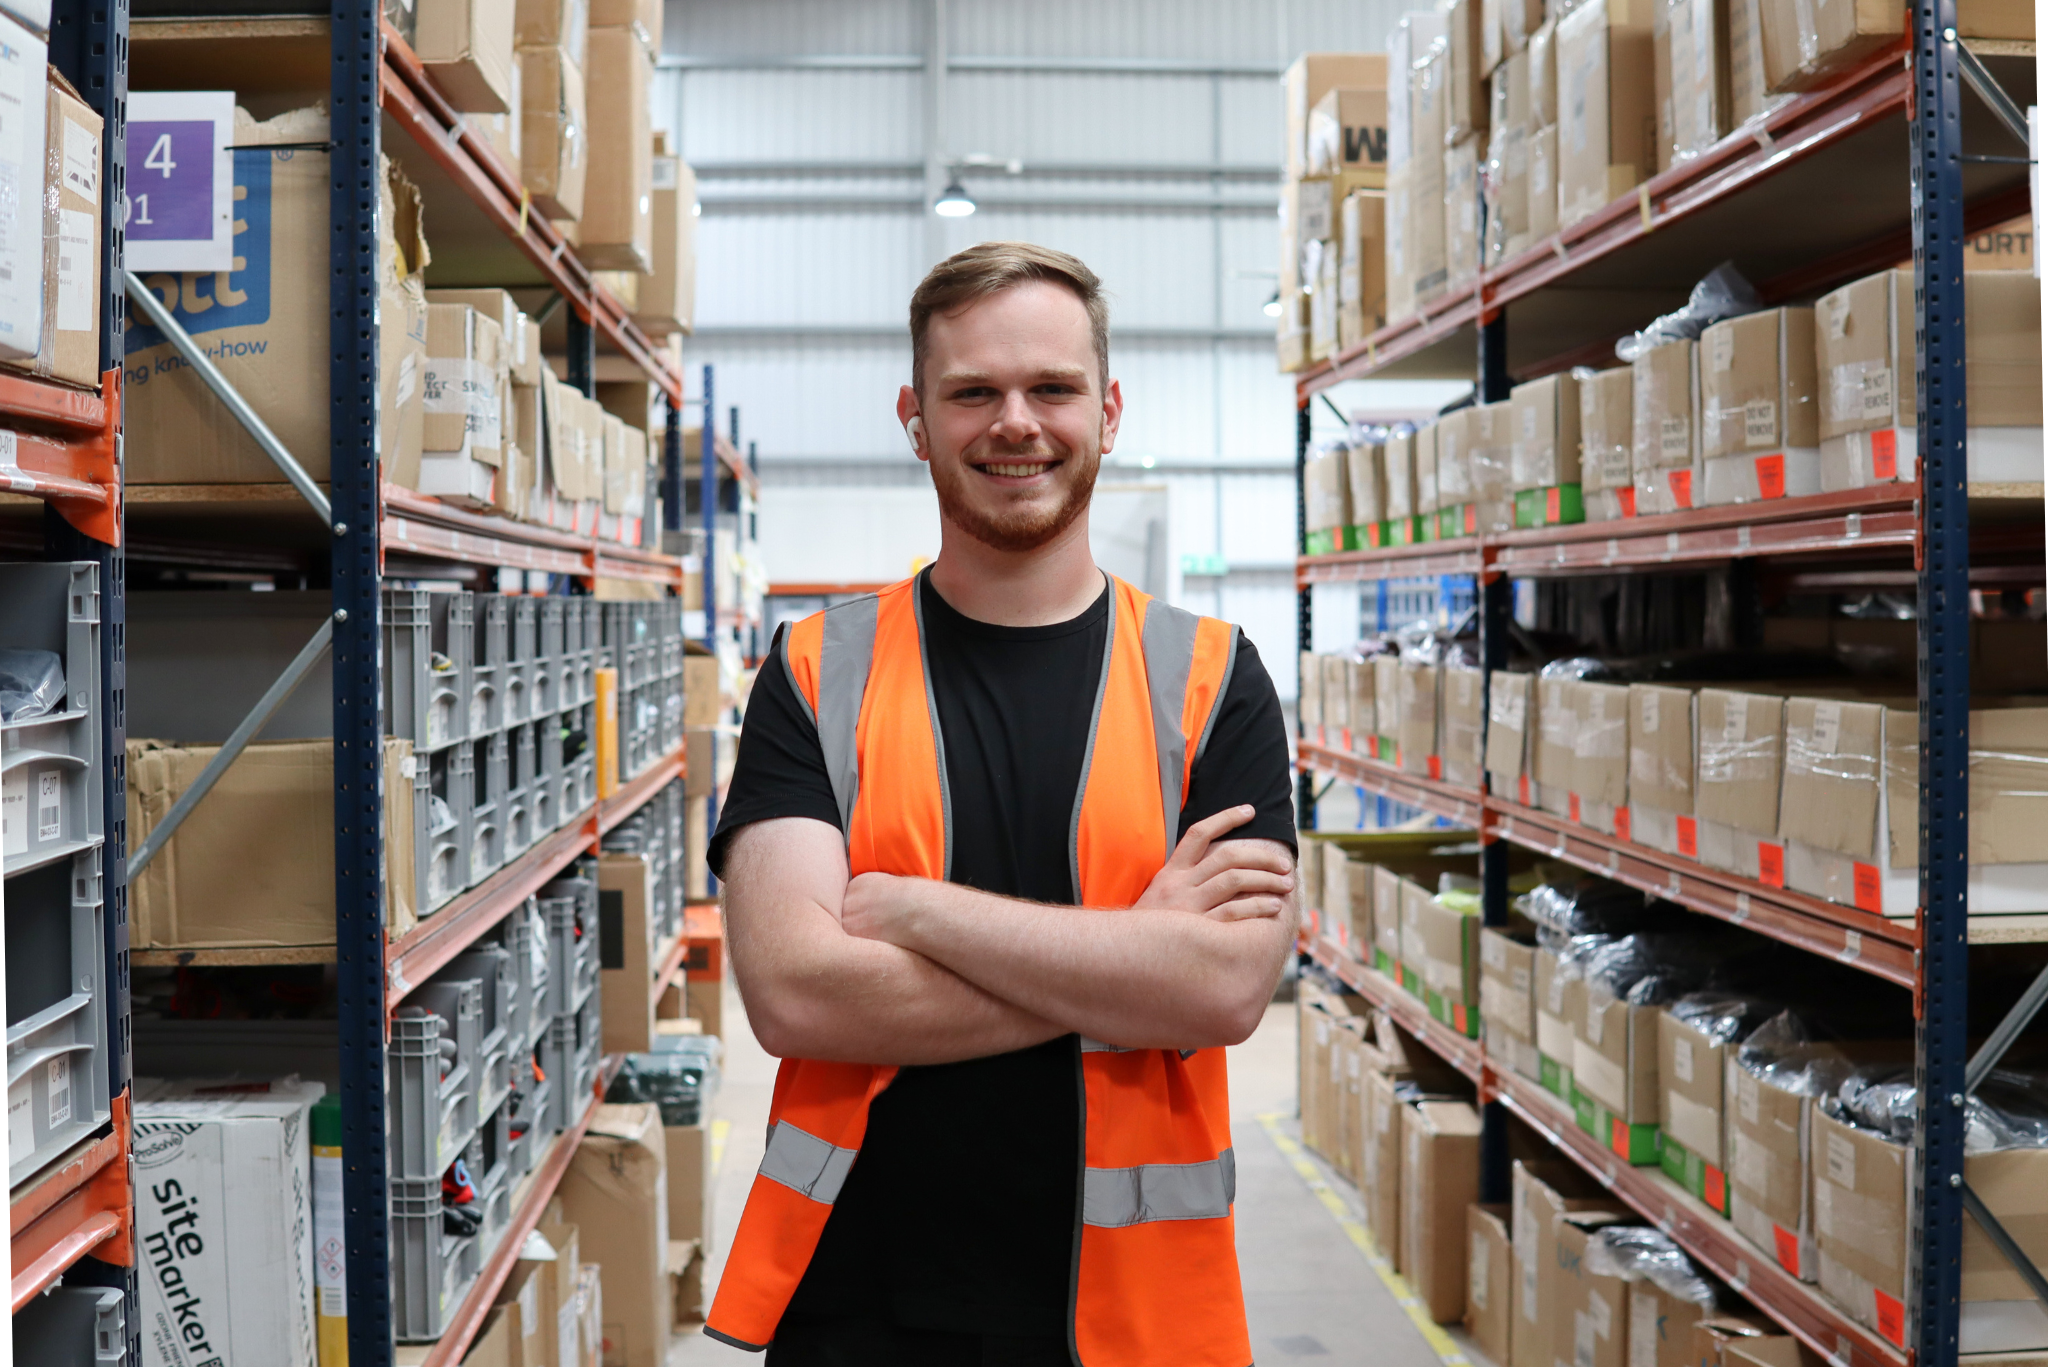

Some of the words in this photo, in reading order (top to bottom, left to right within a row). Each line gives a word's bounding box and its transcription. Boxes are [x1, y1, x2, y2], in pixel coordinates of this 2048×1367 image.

[144, 133, 177, 179] 4
[1344, 127, 1387, 163] W
[1963, 232, 2033, 255] ORT
[43, 776, 57, 795] C-07
[52, 1061, 65, 1082] C-01
[152, 1178, 204, 1259] site
[144, 1231, 213, 1354] marker
